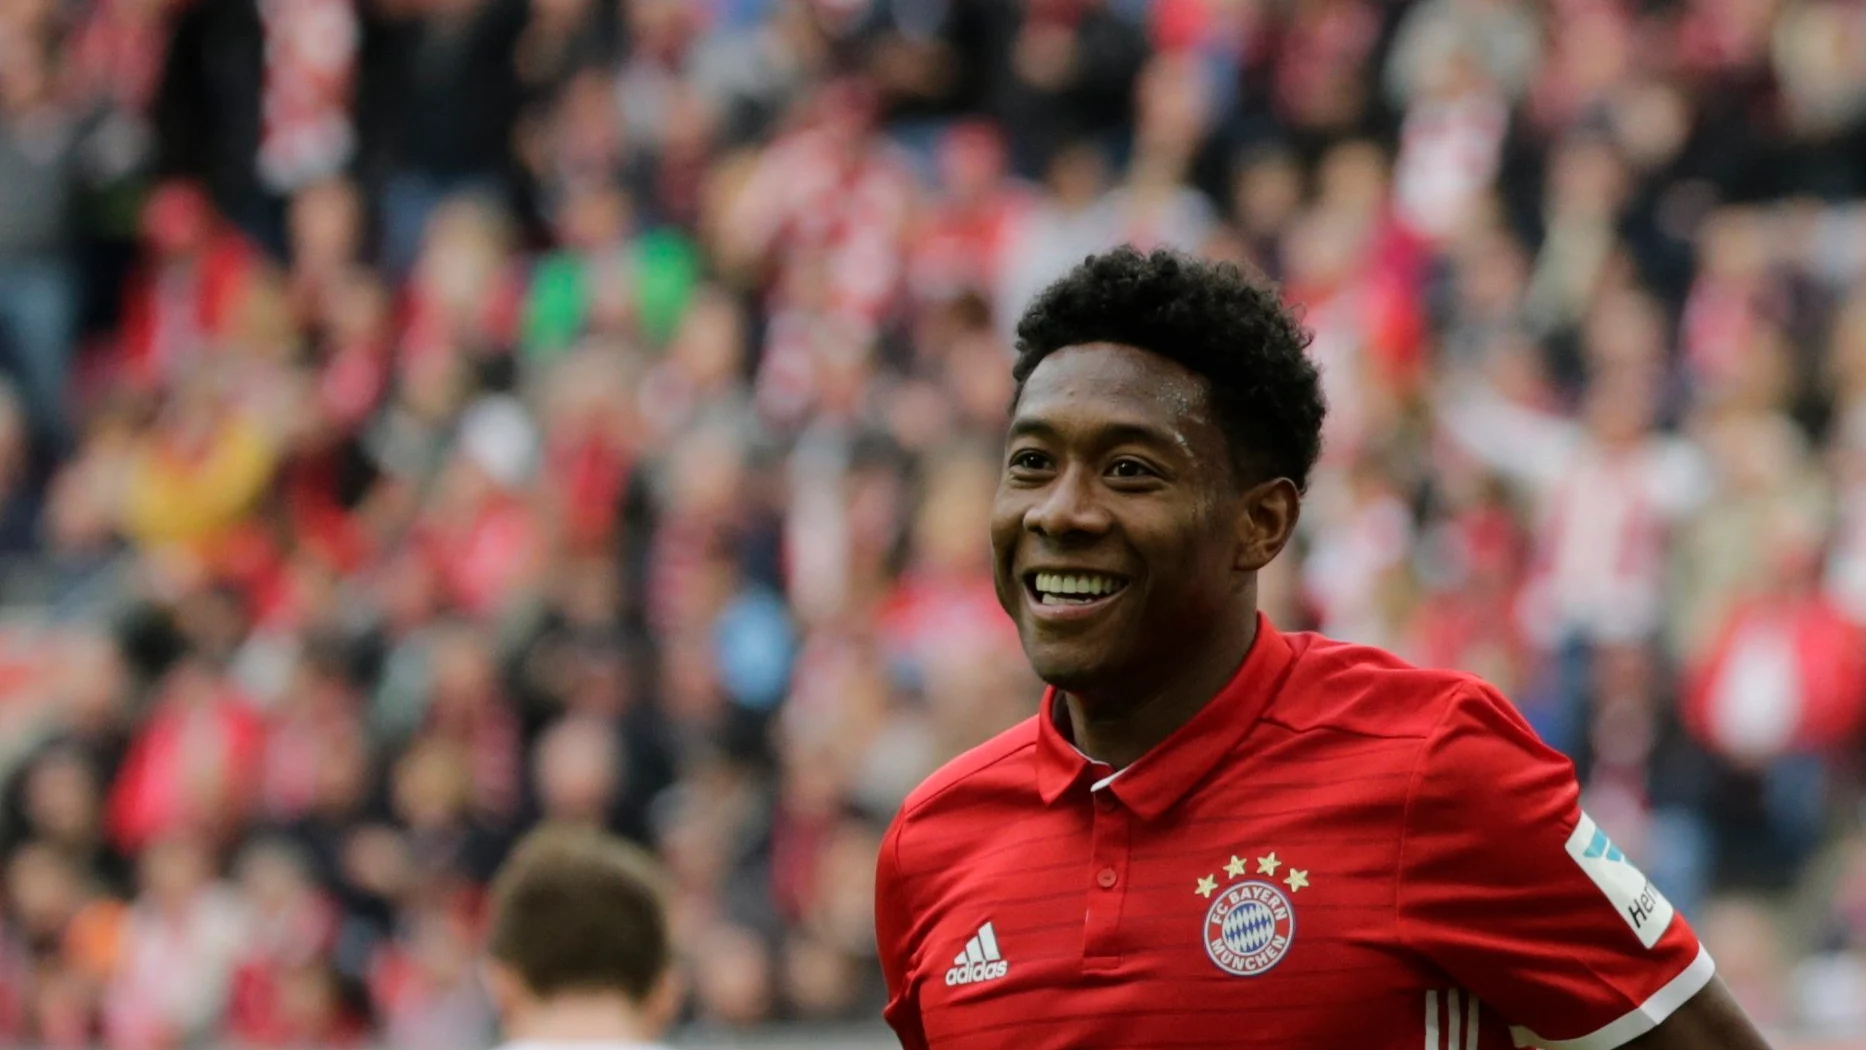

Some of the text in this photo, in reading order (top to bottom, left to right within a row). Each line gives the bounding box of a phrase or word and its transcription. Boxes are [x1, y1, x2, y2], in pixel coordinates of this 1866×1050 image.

[1210, 885, 1288, 925] FC BAYERN
[1210, 934, 1288, 971] MÜNCHEN
[945, 959, 1008, 987] adidas
